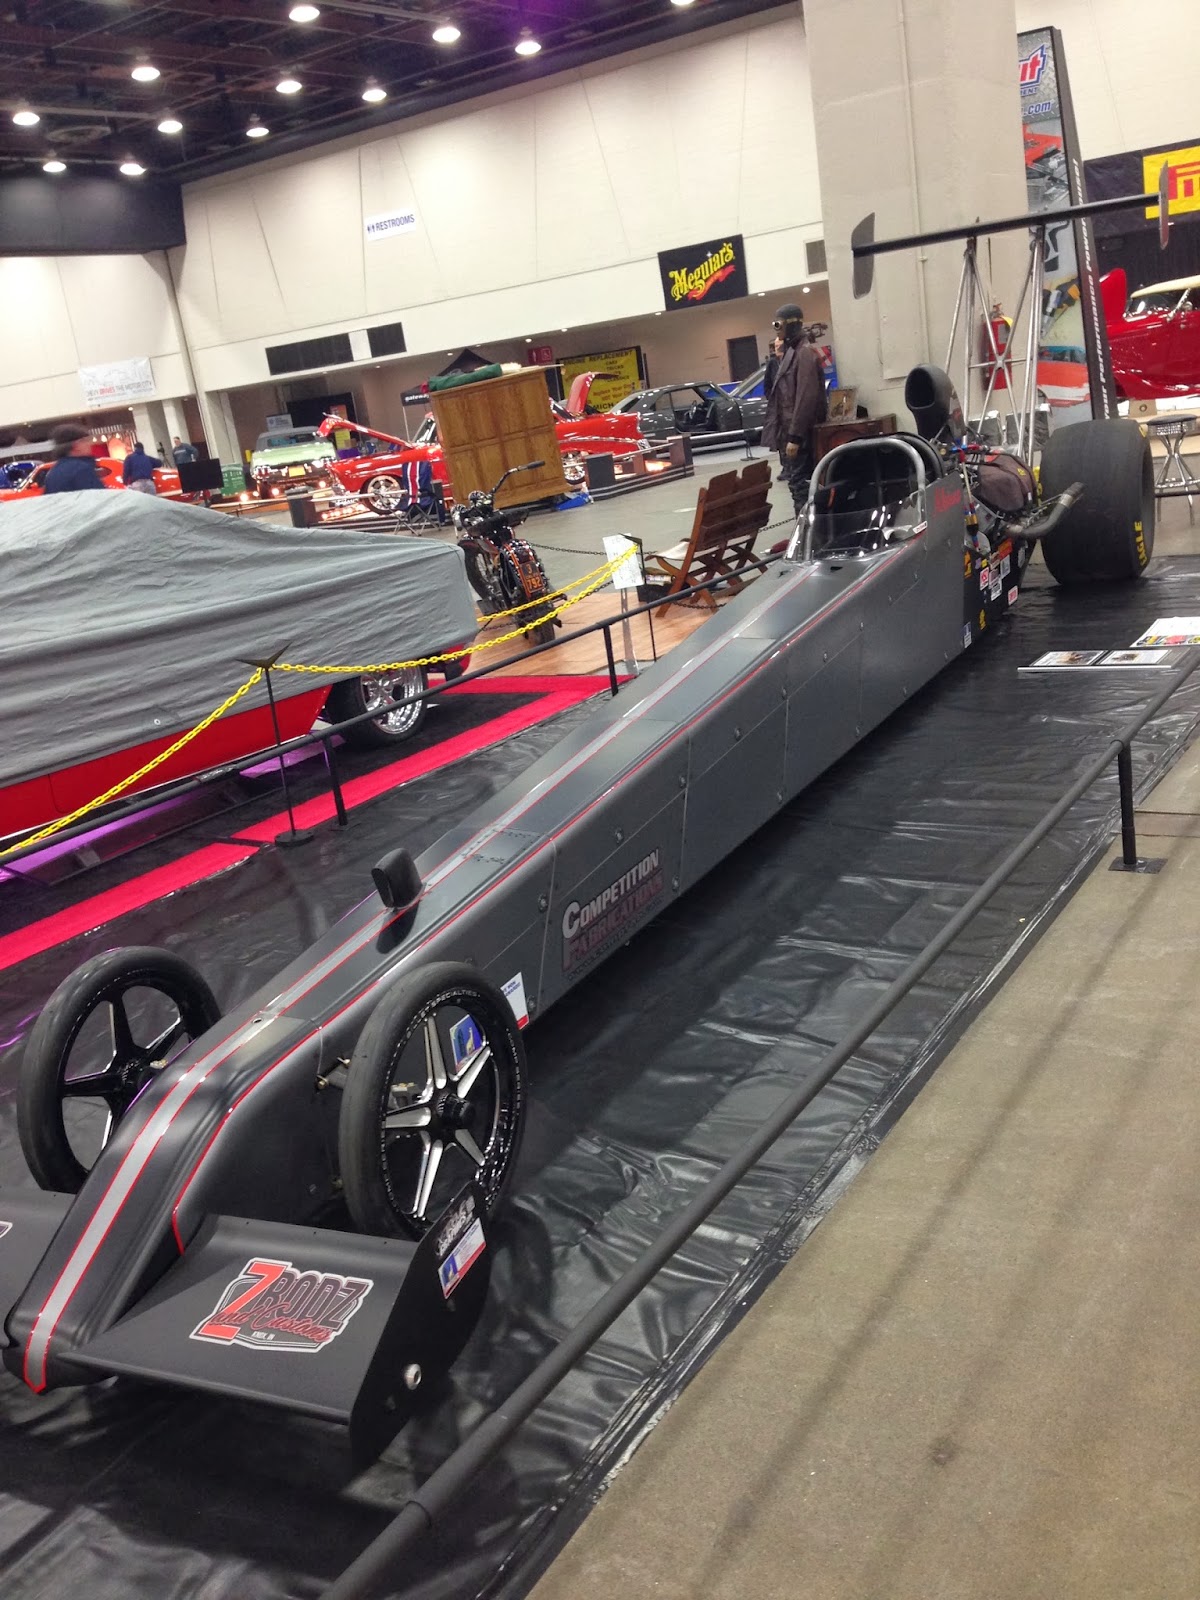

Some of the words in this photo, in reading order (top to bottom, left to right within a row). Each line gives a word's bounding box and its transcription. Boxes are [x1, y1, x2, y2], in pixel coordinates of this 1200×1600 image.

[375, 214, 415, 231] RESTROOMS
[1072, 158, 1091, 271] Powerouse!
[668, 242, 734, 301] Meguiar's
[1085, 275, 1106, 383] Performance
[527, 577, 542, 589] 792
[562, 848, 659, 939] COMPETITION
